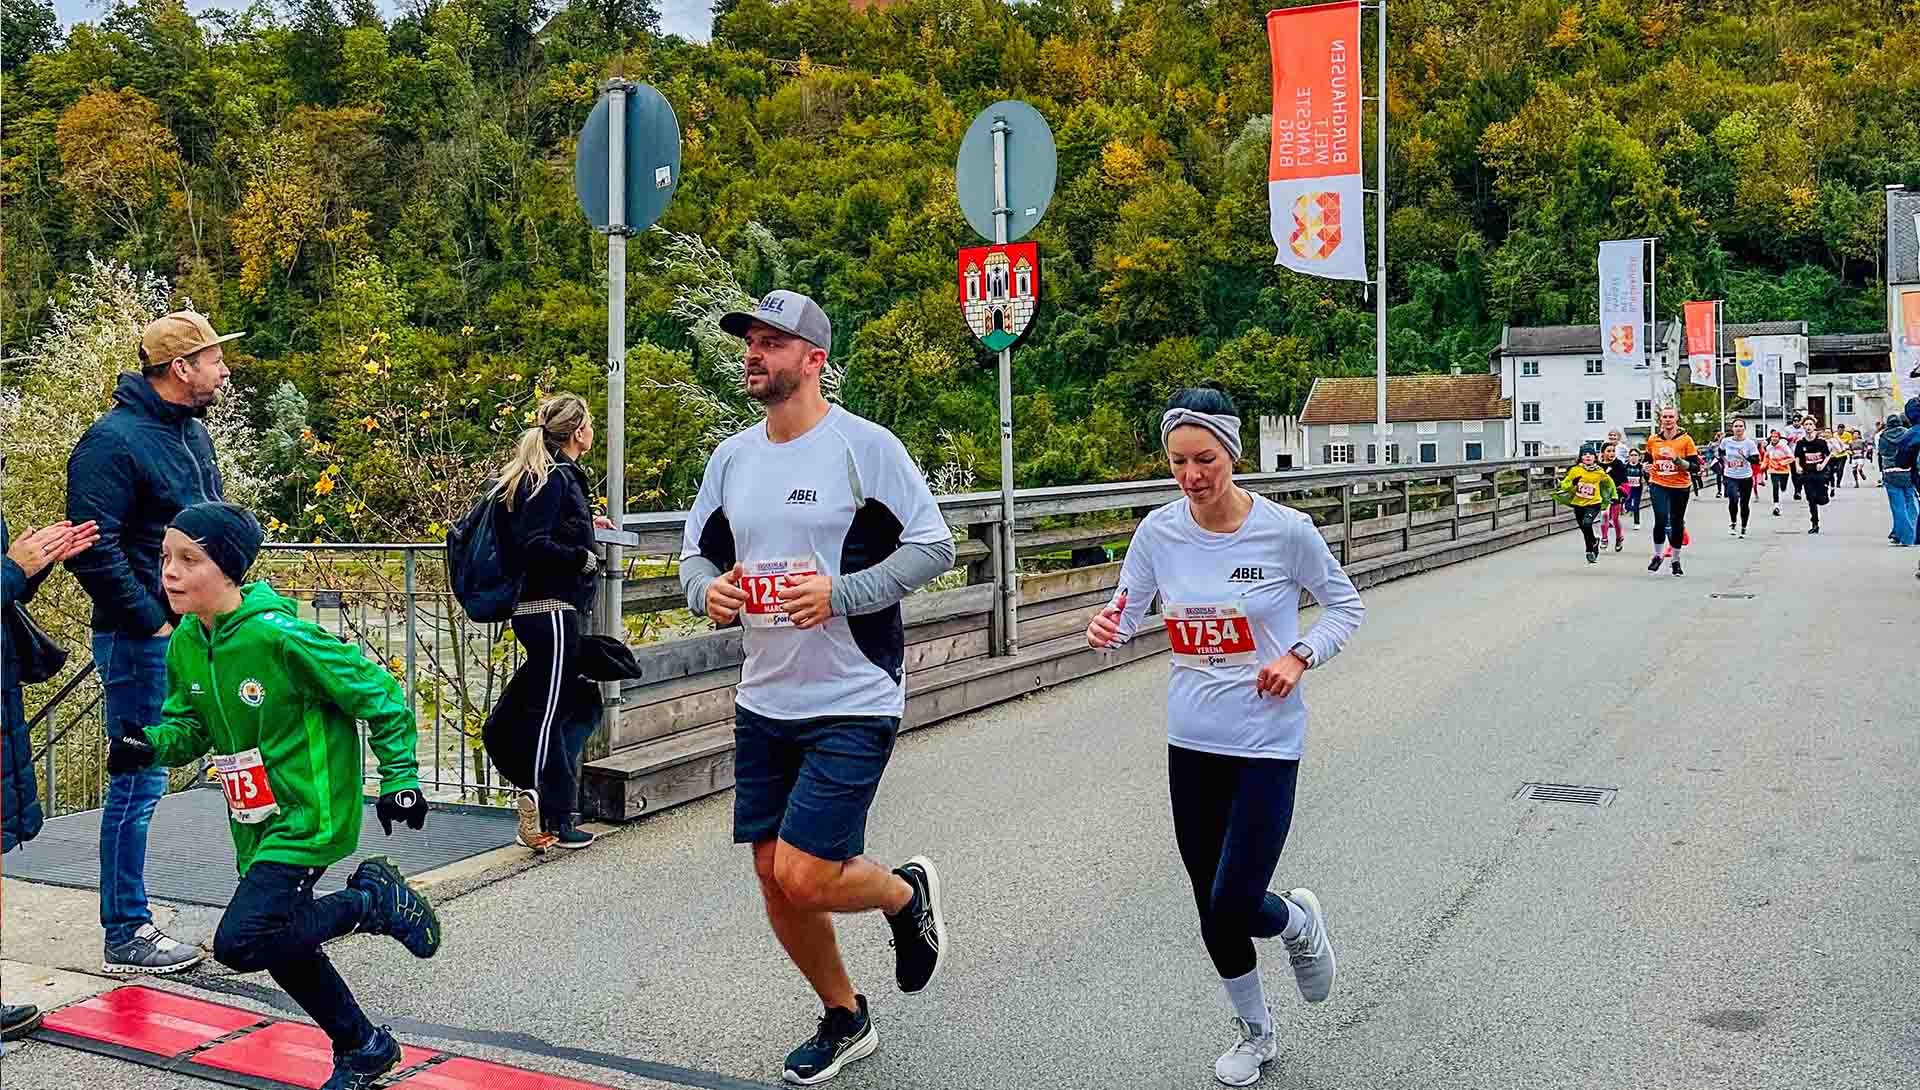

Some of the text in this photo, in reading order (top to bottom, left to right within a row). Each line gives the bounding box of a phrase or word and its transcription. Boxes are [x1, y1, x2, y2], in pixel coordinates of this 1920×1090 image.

[787, 489, 818, 502] ABEL
[1230, 567, 1265, 580] ABEL
[1176, 620, 1240, 646] 1754
[1196, 646, 1224, 654] VERENA
